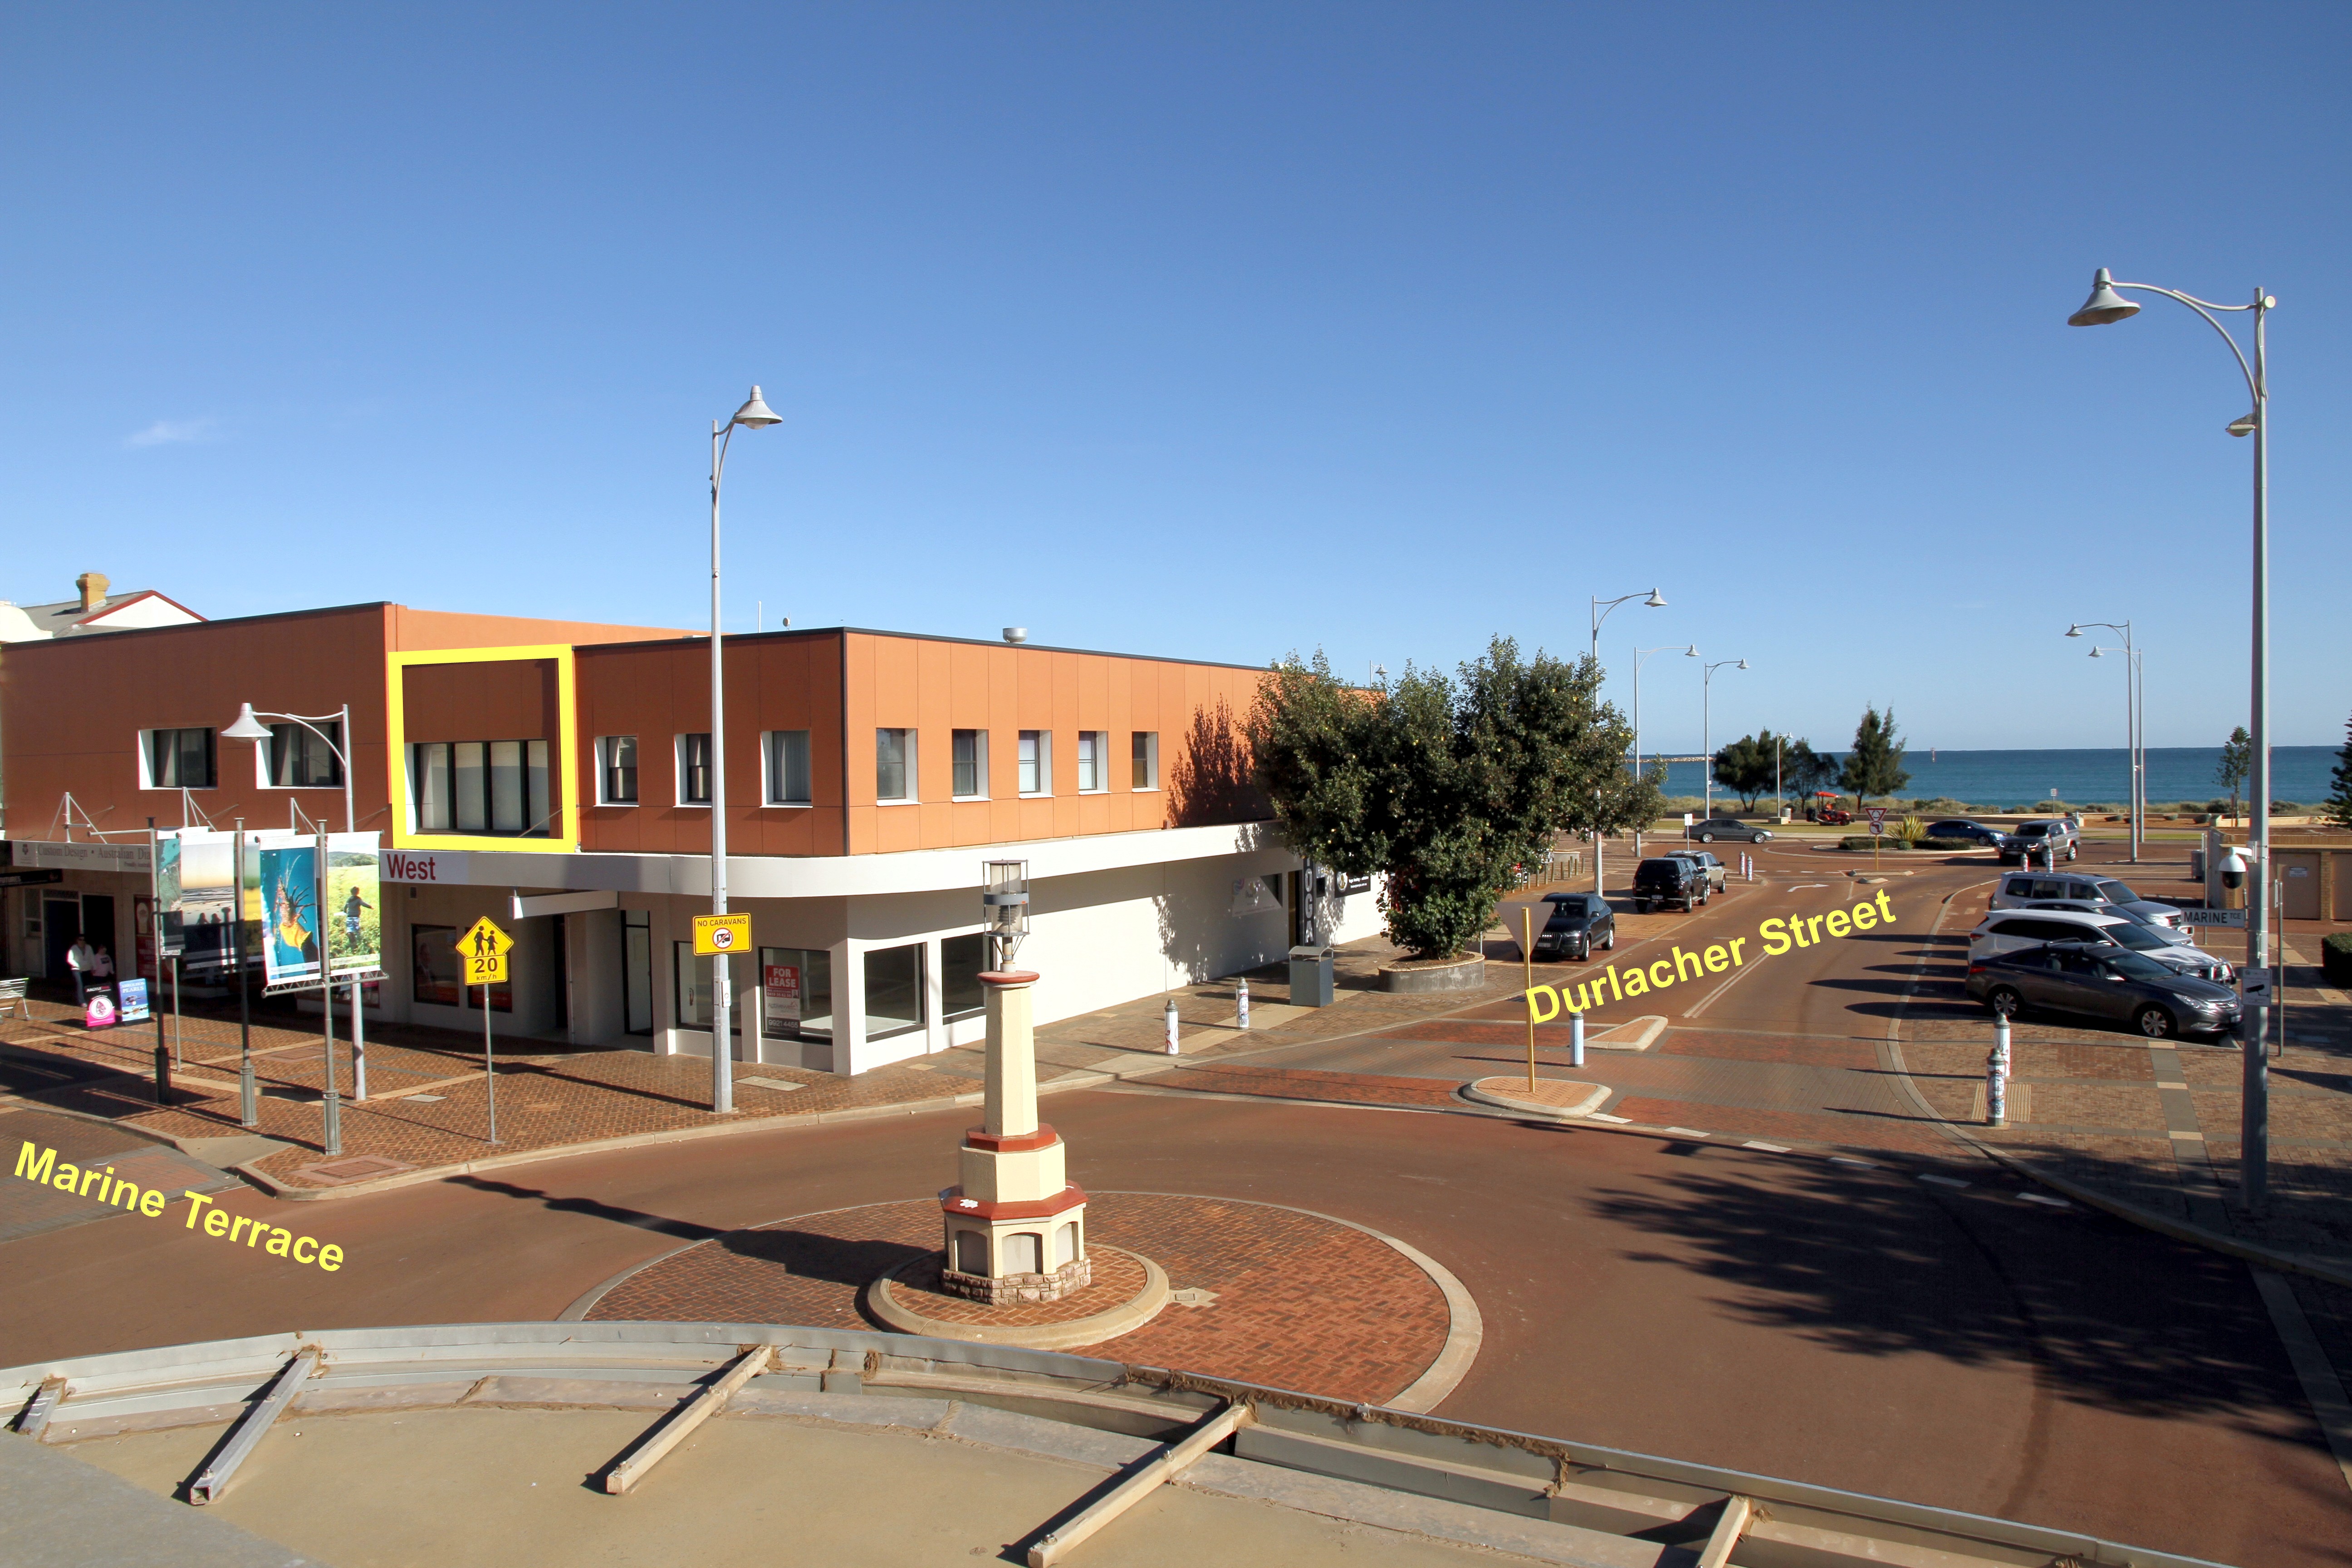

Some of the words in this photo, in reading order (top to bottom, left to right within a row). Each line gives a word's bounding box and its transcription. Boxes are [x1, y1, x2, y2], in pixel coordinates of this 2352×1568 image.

[38, 844, 62, 856] Custom
[64, 845, 88, 860] Design
[98, 847, 133, 859] Australian
[387, 854, 436, 880] West
[710, 918, 746, 926] CARAVANS
[2184, 911, 2228, 923] MARINE
[475, 958, 498, 973] 20
[773, 968, 791, 977] FOR
[769, 977, 796, 988] LEASE
